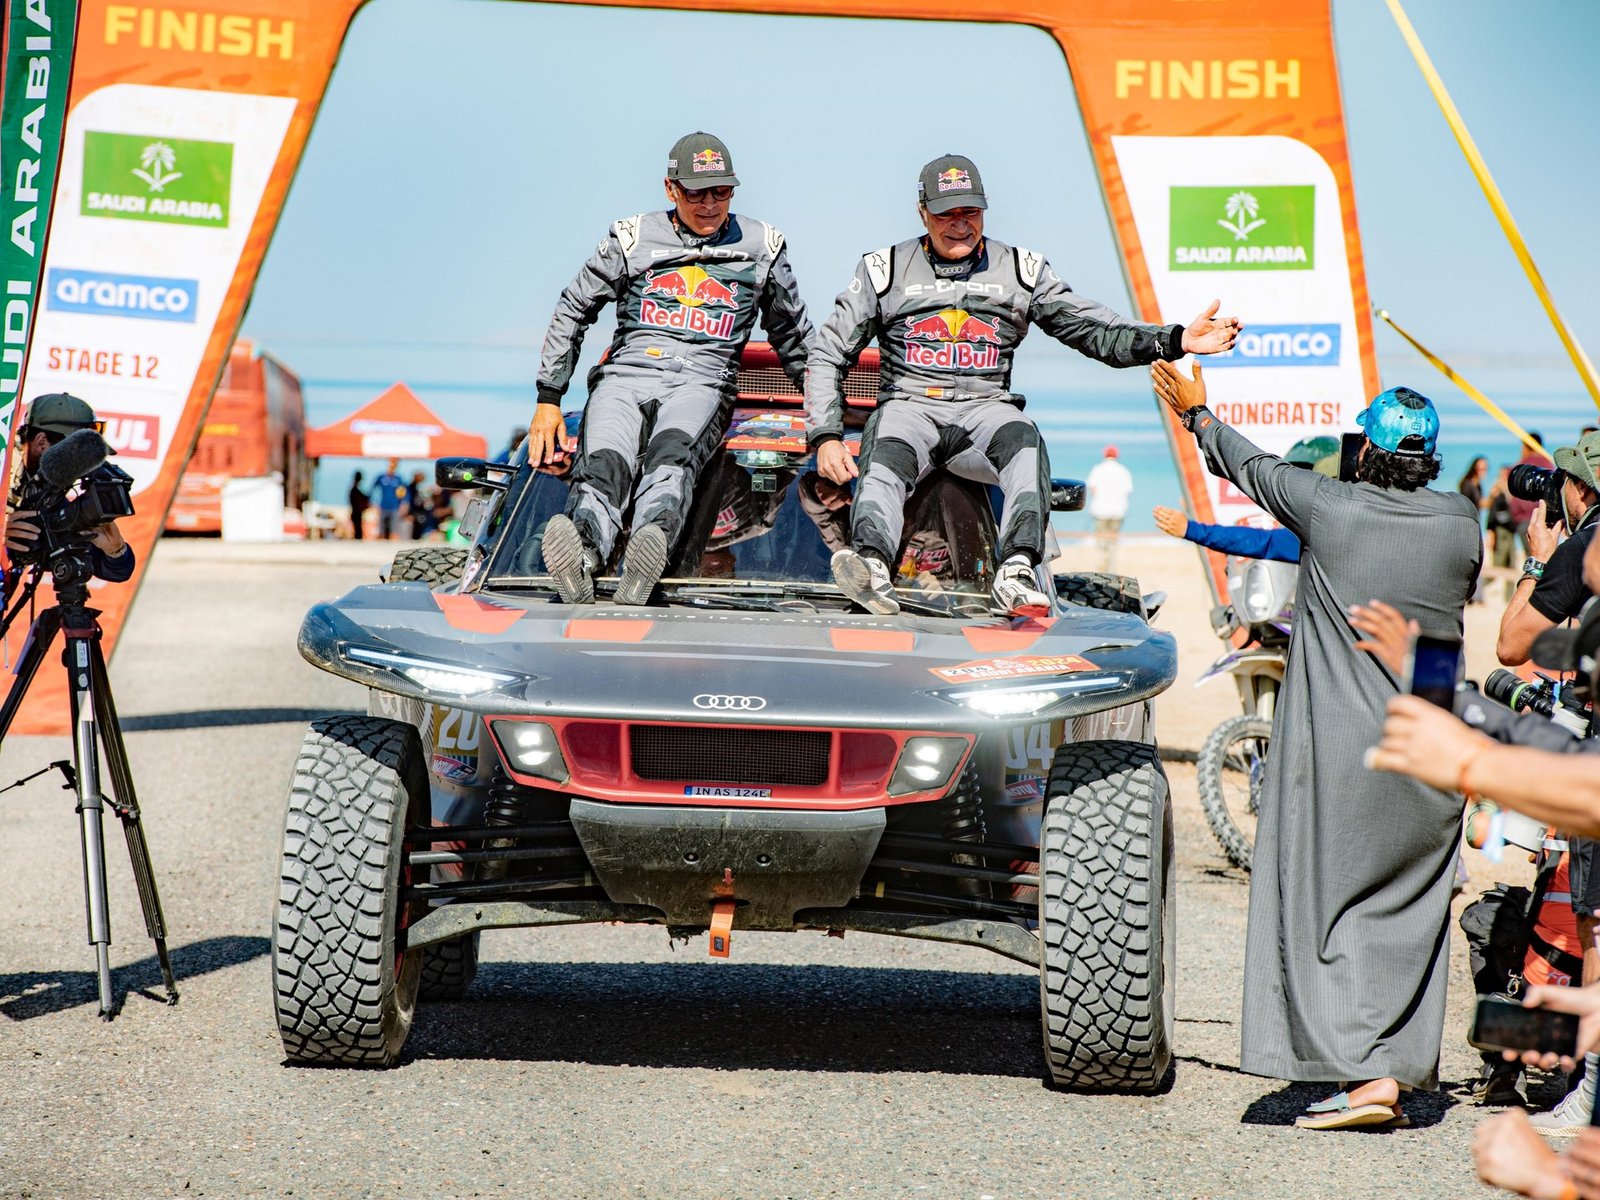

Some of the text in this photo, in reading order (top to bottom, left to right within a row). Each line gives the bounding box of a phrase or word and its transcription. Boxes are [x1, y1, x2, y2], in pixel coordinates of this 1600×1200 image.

[105, 5, 294, 60] FINISH
[1115, 59, 1300, 100] FINISH
[939, 180, 972, 191] Red Bull
[87, 192, 223, 221] SAUDI ARABIA
[1175, 245, 1307, 264] SAUDI ARABIA
[56, 277, 190, 313] aramco
[905, 279, 1003, 297] e-tron
[640, 299, 737, 341] Red Bull
[48, 346, 160, 379] STAGE 12
[905, 342, 999, 370] Red Bull
[1216, 402, 1341, 425] CONGRATS!
[696, 787, 768, 798] IN AS 124E
